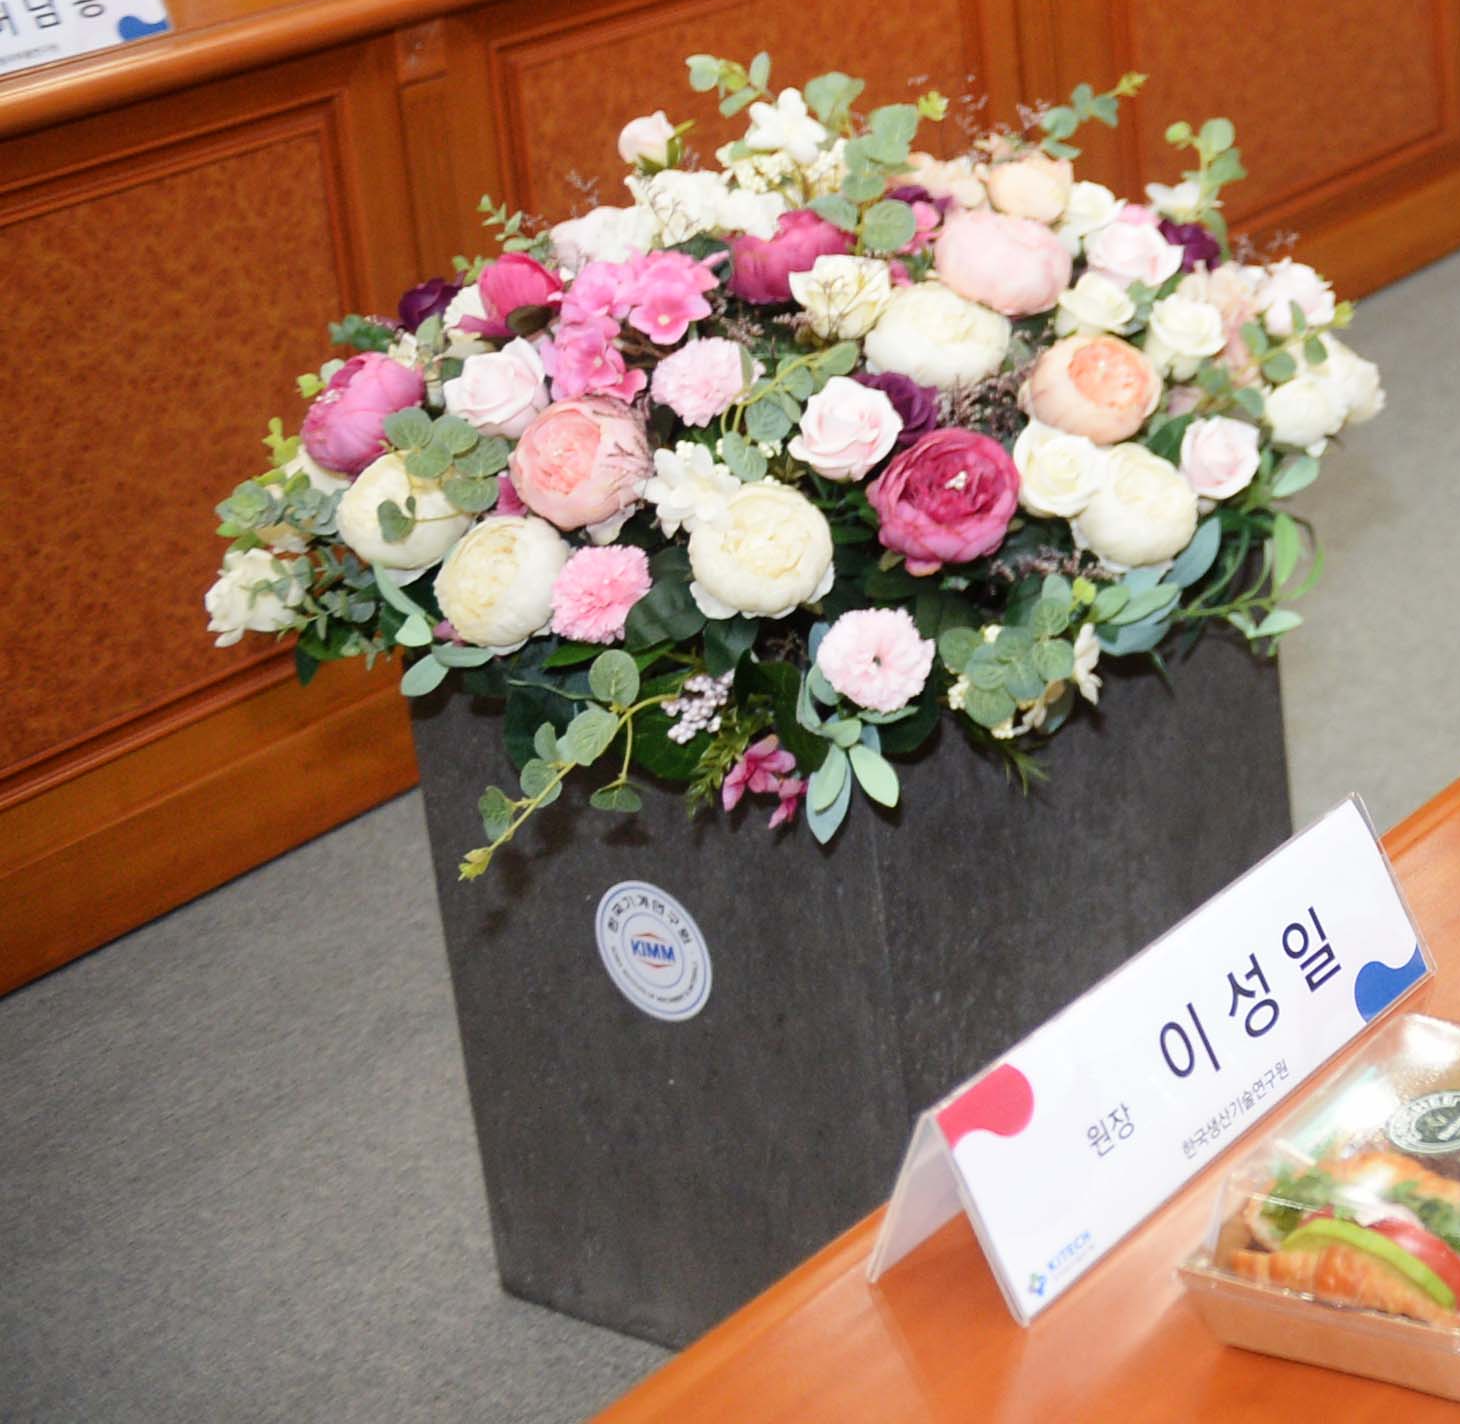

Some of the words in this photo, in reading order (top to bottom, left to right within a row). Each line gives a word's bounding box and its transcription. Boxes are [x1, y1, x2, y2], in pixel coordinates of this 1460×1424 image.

[630, 939, 676, 961] KIMM
[1158, 907, 1342, 1078] 이성일
[1086, 1104, 1135, 1157] 원장
[1181, 1059, 1290, 1160] 한국생산기술연구원
